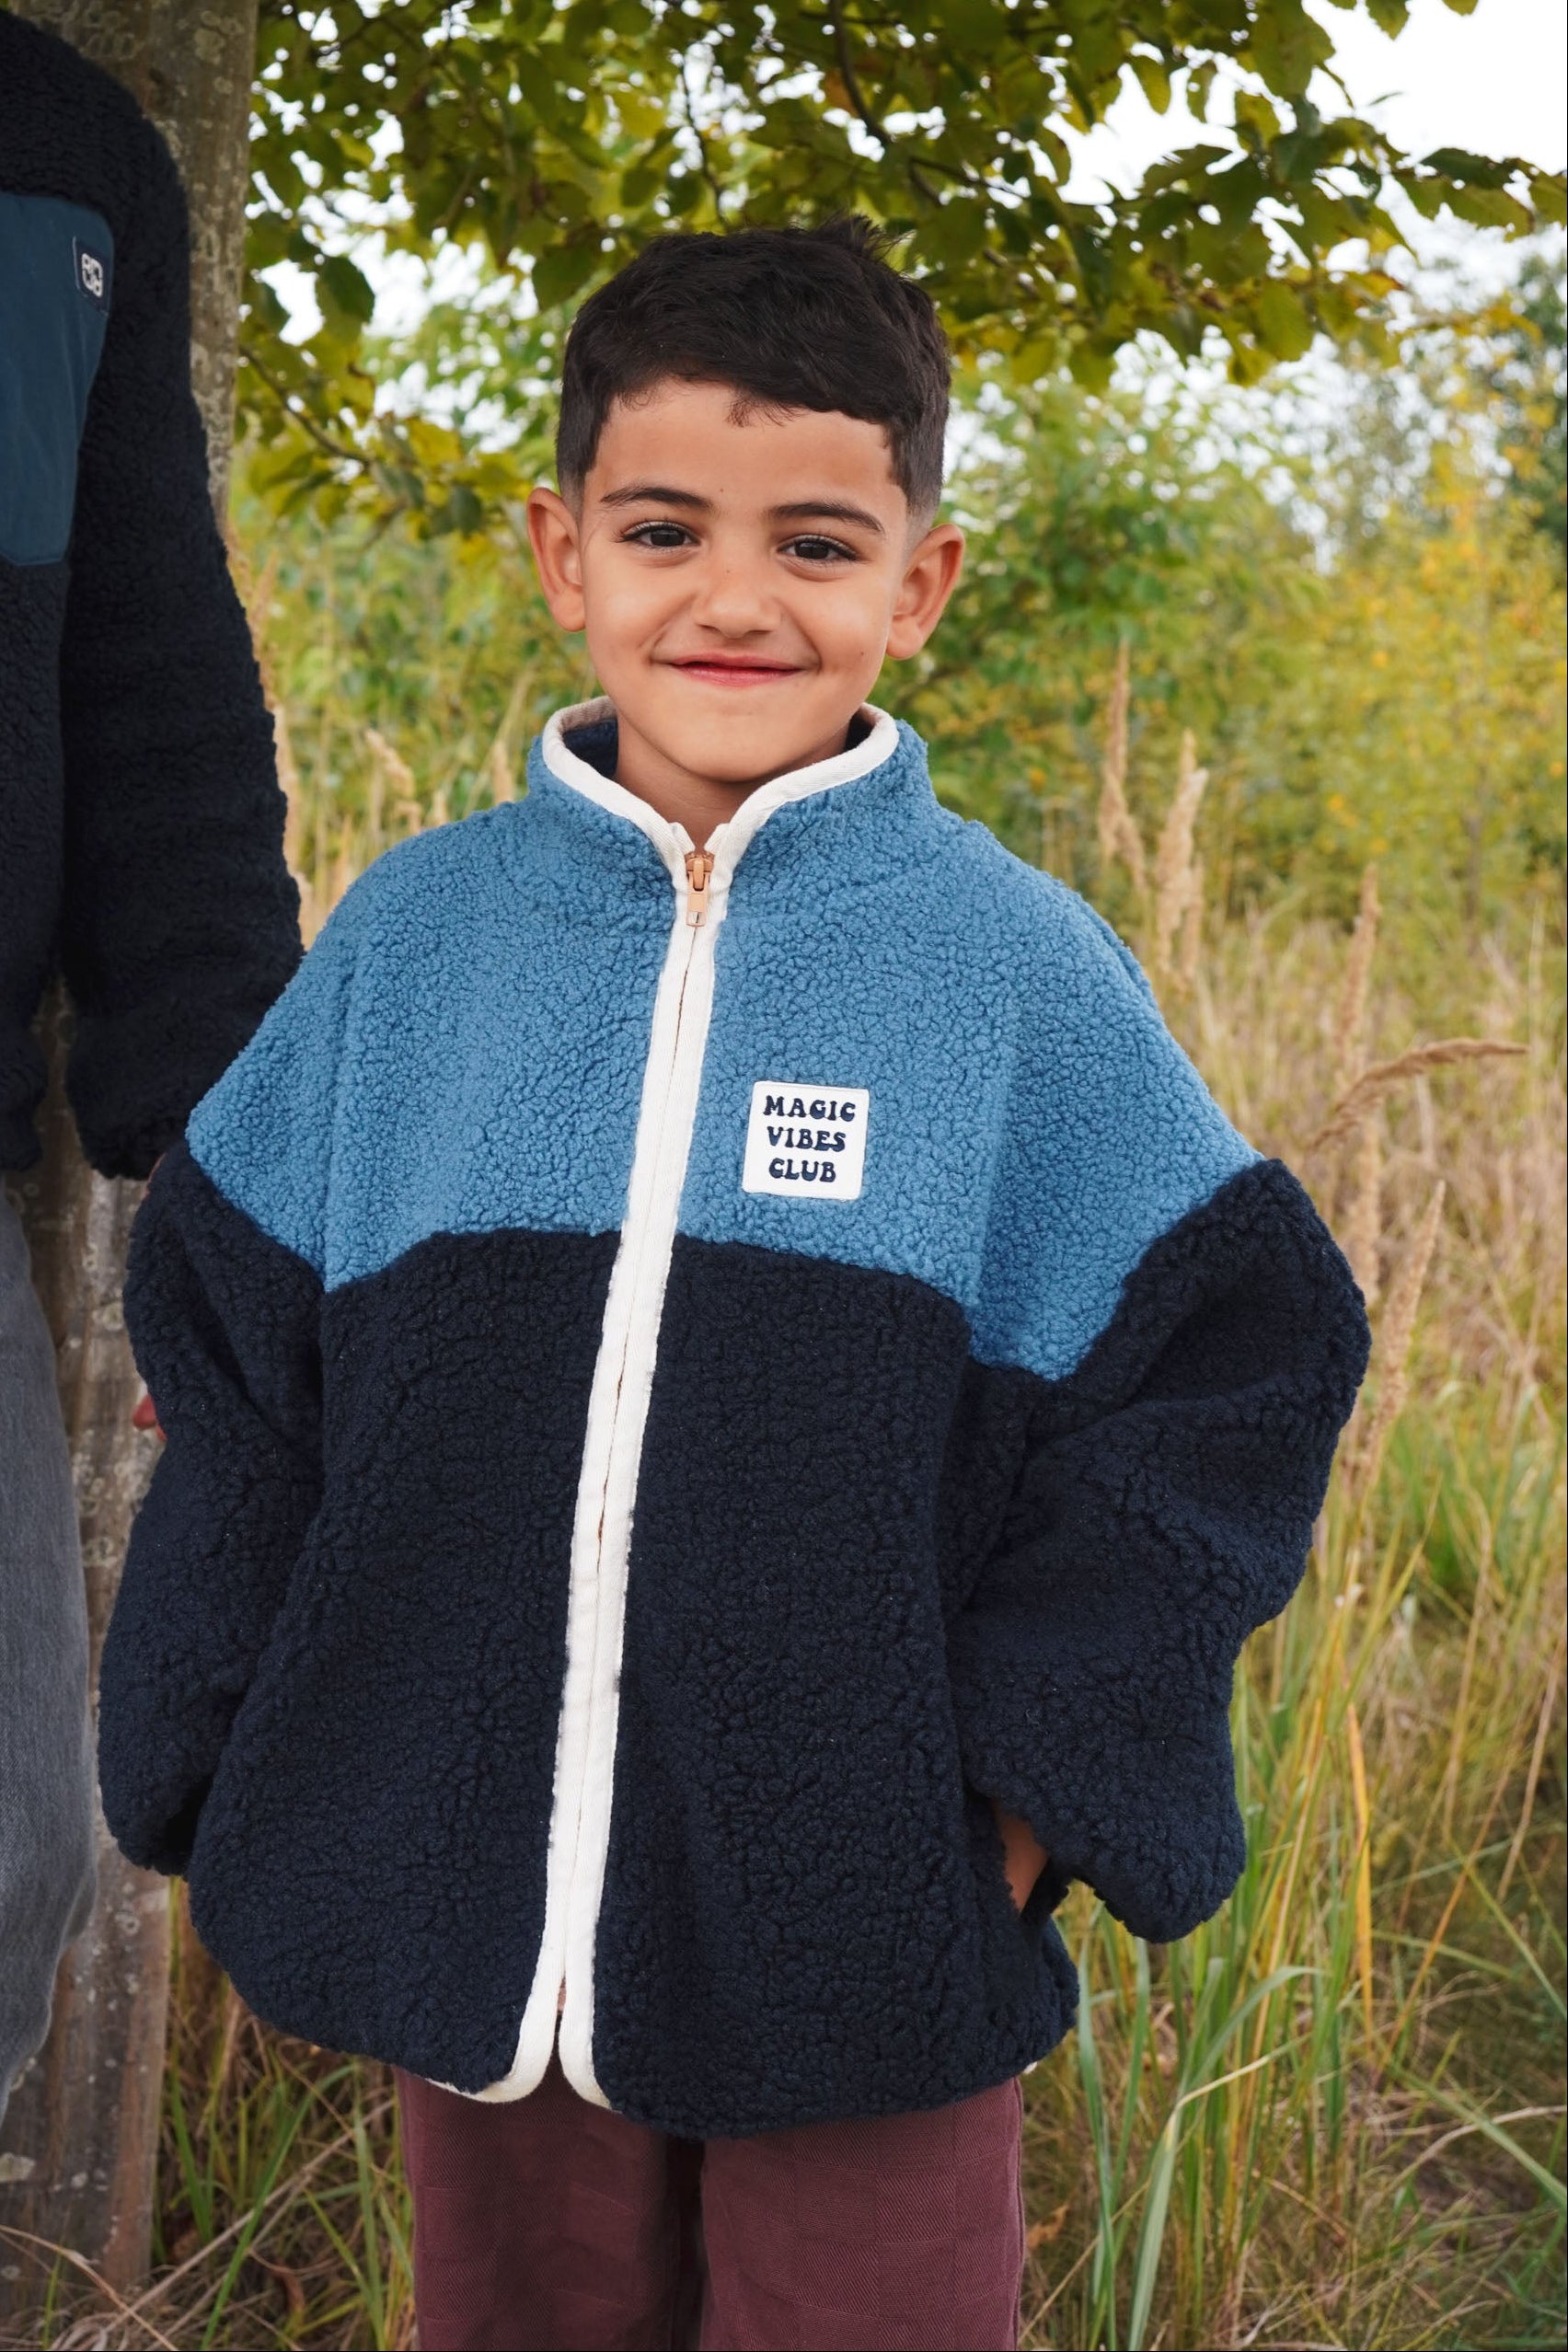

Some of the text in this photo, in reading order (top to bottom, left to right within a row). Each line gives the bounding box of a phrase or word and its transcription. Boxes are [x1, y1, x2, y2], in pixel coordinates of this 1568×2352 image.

[763, 1095, 856, 1122] MAGIC
[767, 1125, 847, 1152] VIBES
[768, 1157, 836, 1183] CLUB
